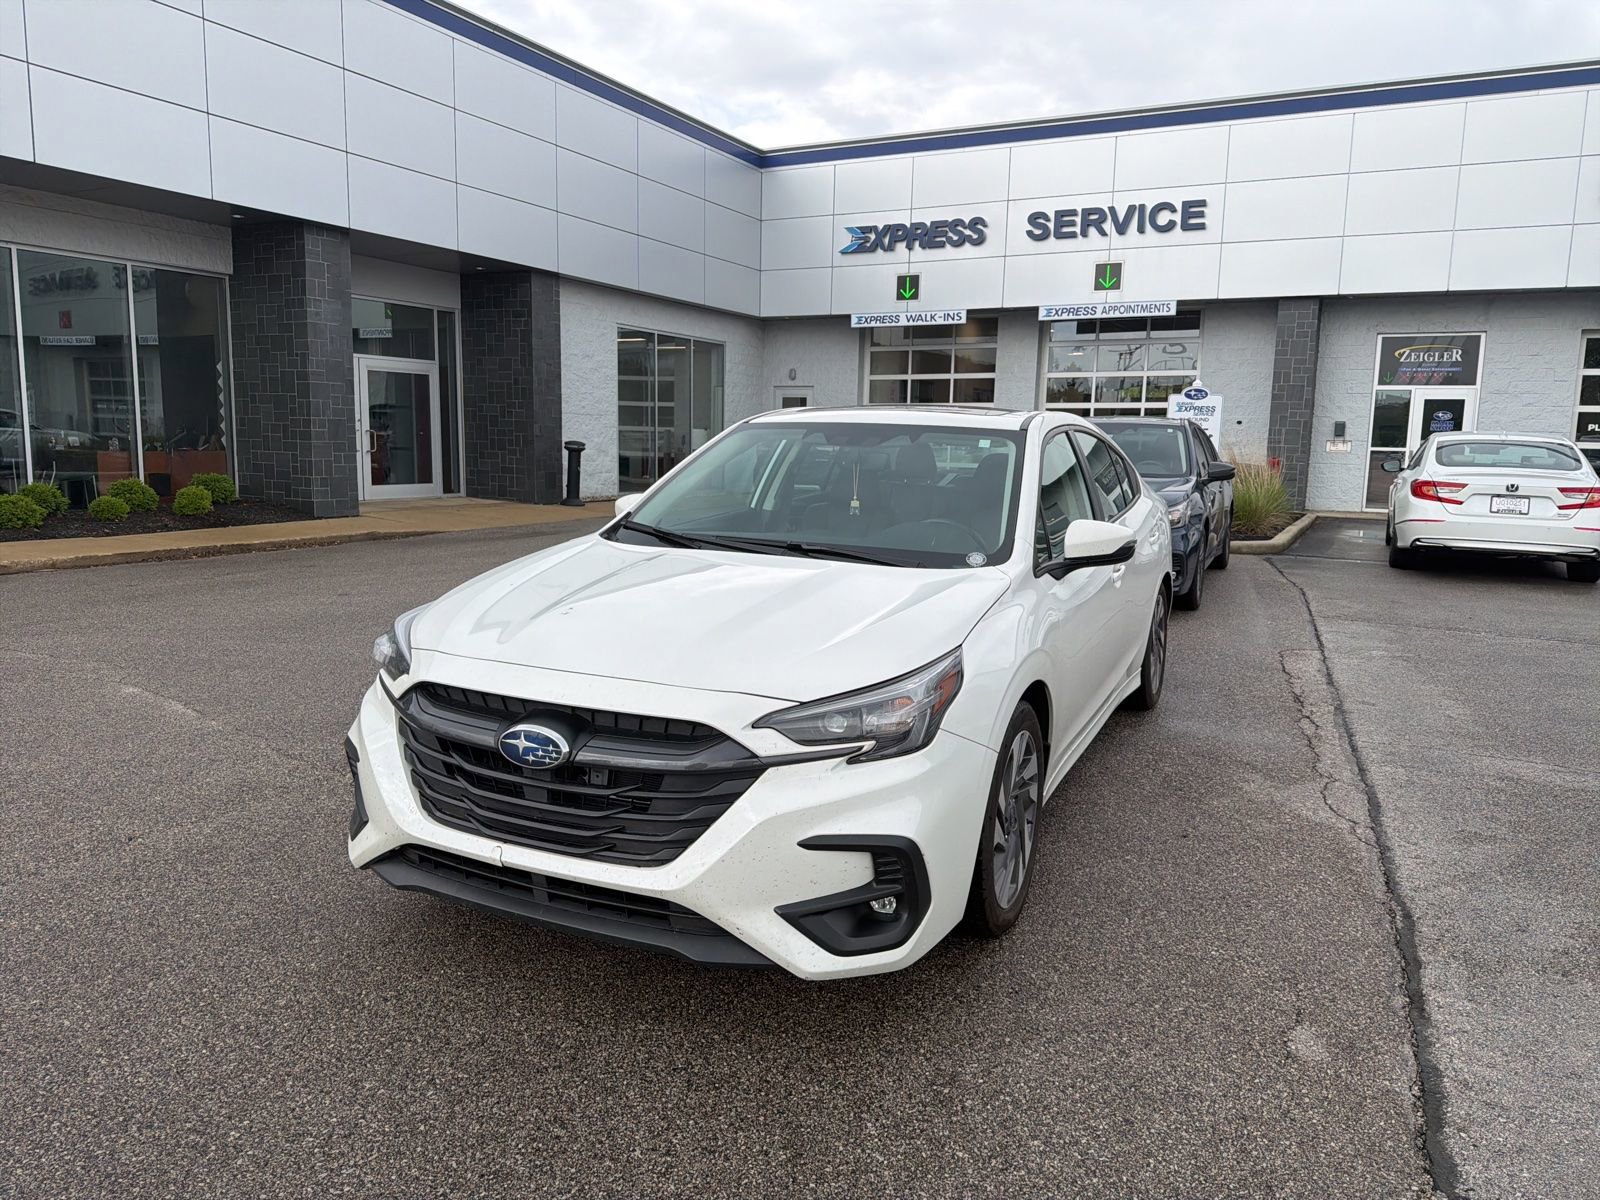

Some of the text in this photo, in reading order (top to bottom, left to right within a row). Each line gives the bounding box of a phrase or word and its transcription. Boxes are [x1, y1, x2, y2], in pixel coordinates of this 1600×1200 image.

[839, 198, 1208, 254] EXPRESS SERVICE
[1042, 302, 1171, 318] EXPRESS APPOINTMENTS
[854, 311, 963, 325] EXPRESS WALK-INS
[1400, 348, 1463, 362] ZEIGLER
